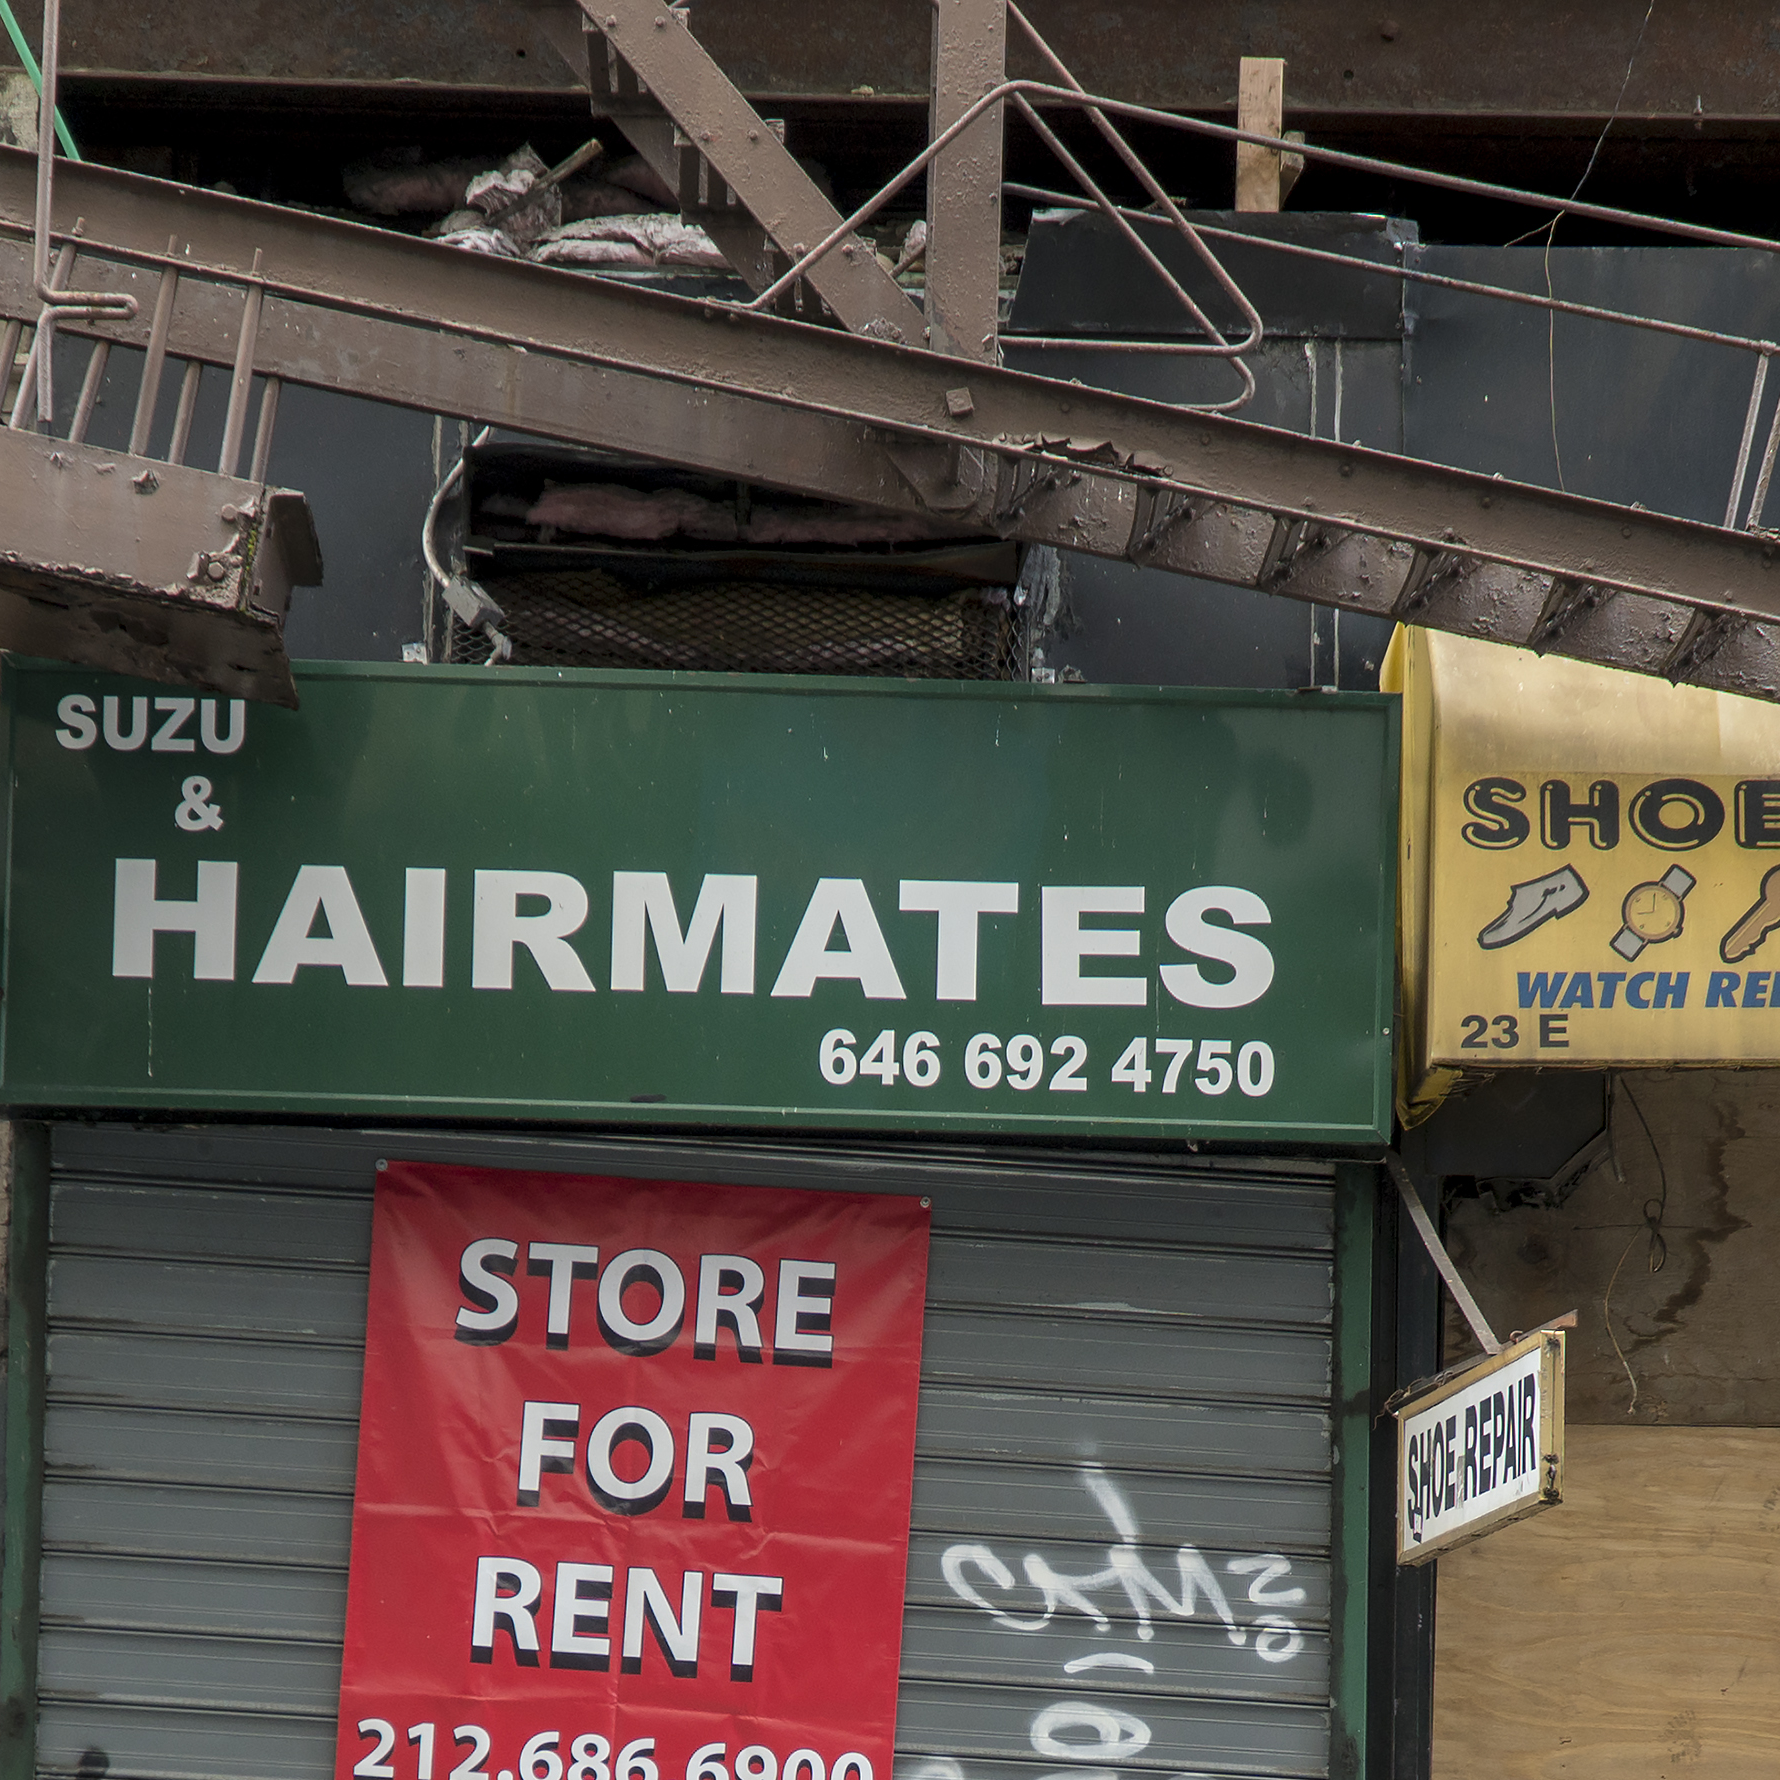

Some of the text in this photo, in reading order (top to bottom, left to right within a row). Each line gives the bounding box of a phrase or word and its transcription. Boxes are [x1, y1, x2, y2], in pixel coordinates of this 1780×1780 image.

[55, 694, 246, 754] SUZU
[174, 775, 224, 831] &
[112, 857, 1275, 1010] HAIRMATES
[1460, 1013, 1570, 1049] 23 E
[1517, 971, 1691, 1010] WATCH
[818, 1028, 1275, 1098] 646 692 4750
[455, 1237, 837, 1369] STORE
[519, 1401, 754, 1522] FOR
[1407, 1373, 1537, 1533] SHOE REPAIR
[470, 1555, 784, 1683] RENT
